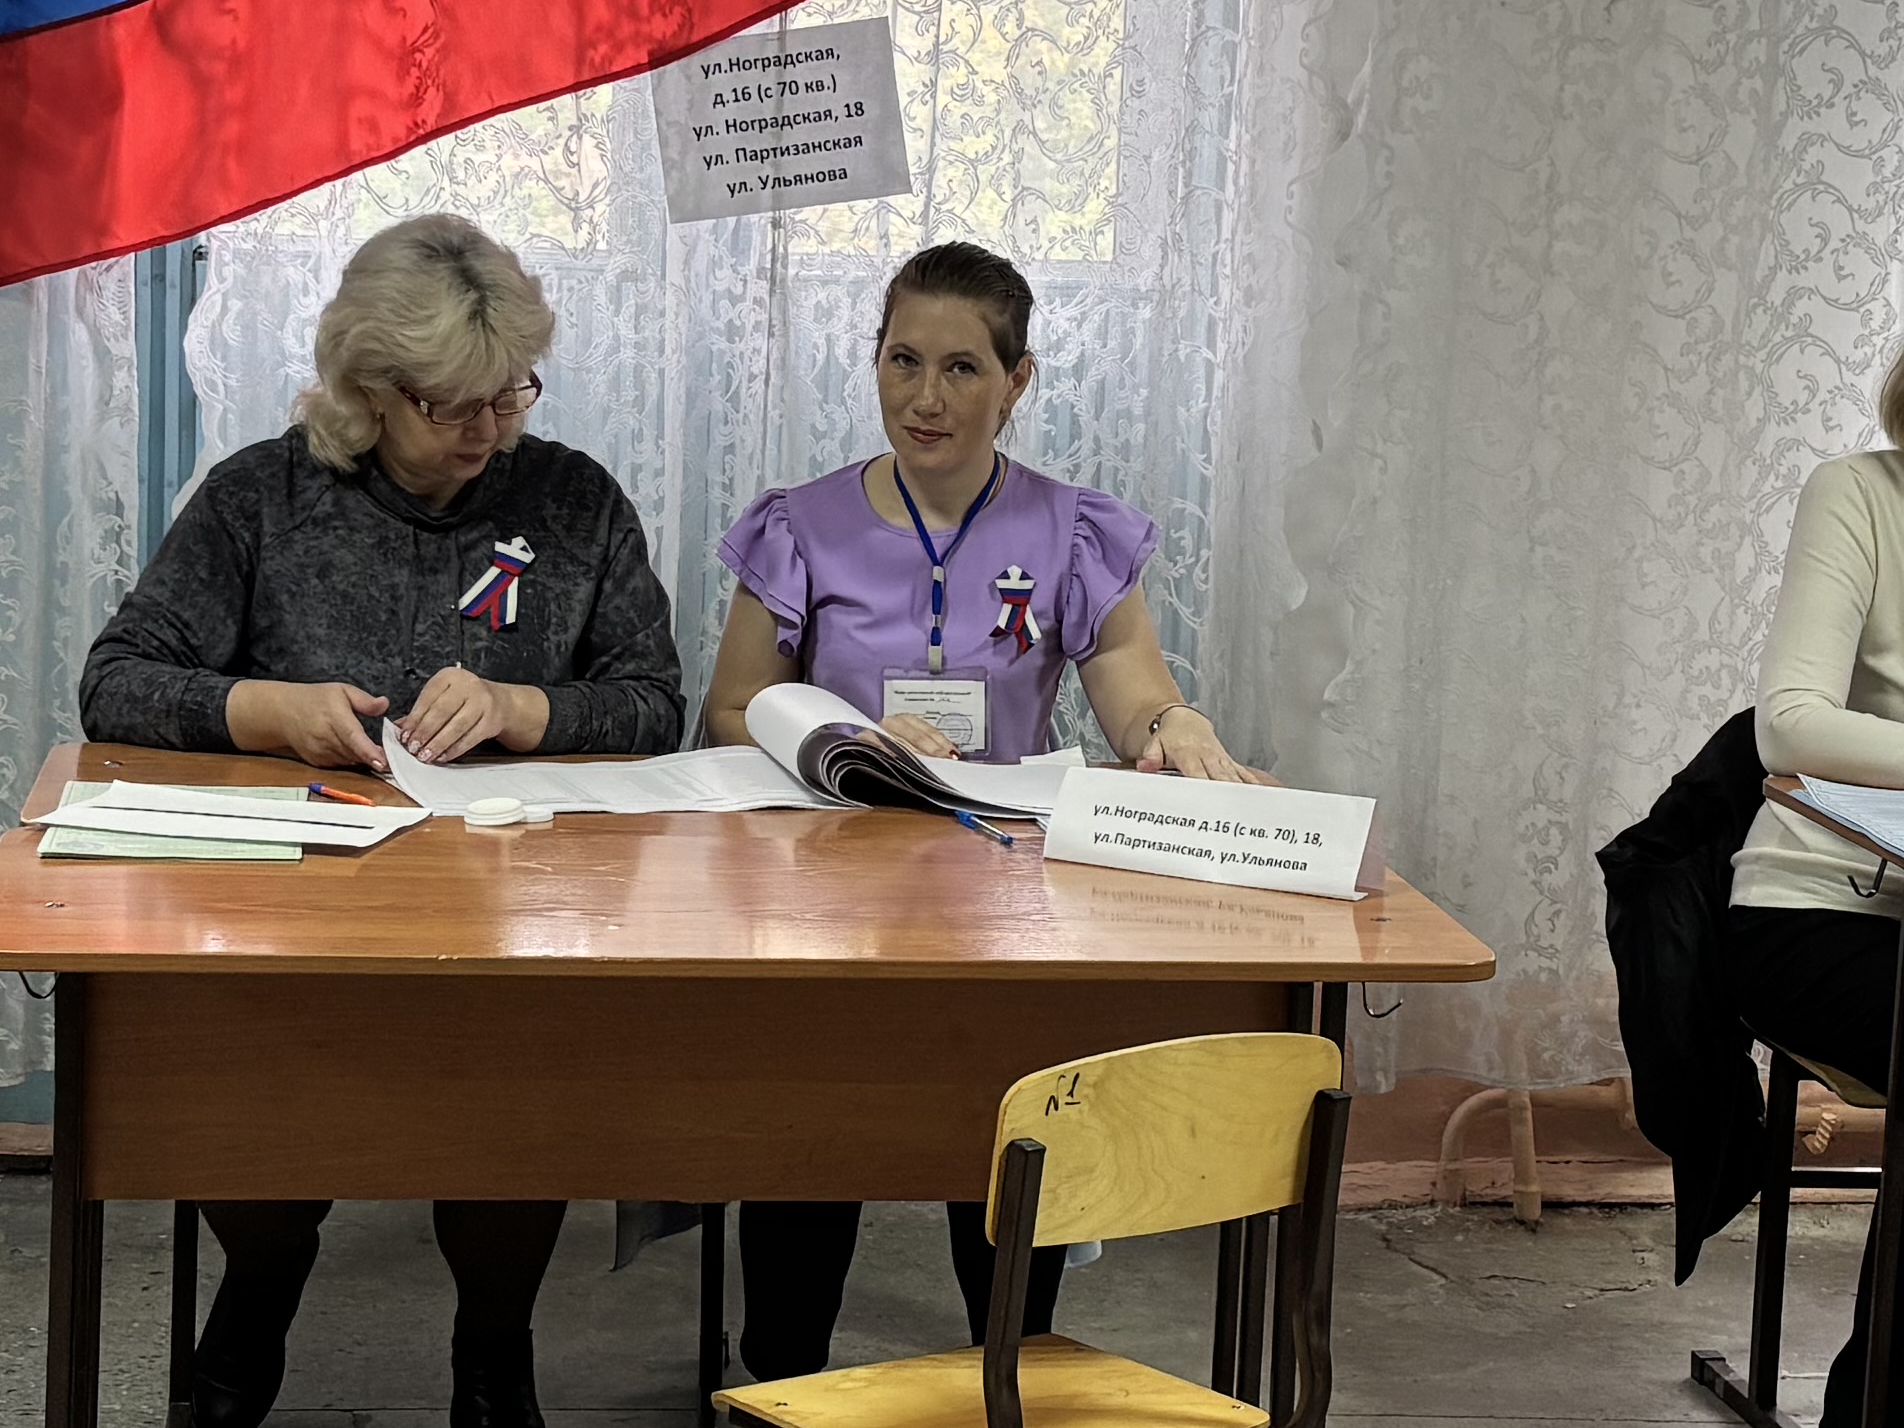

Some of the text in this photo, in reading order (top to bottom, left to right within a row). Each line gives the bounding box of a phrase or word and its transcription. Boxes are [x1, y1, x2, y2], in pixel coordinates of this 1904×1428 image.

[701, 47, 841, 79] ул.Ноградская,
[713, 74, 837, 108] д.16 (с 70 кв.)
[693, 102, 865, 141] ул. Ноградская, 18
[703, 134, 863, 170] ул. Партизанская
[727, 167, 848, 197] ул. Ульянова
[1094, 803, 1323, 847] ул.Ноградская д.16 (с кв. 70), 18,
[1094, 830, 1309, 871] ул.Партизанская, ул.Ульянова
